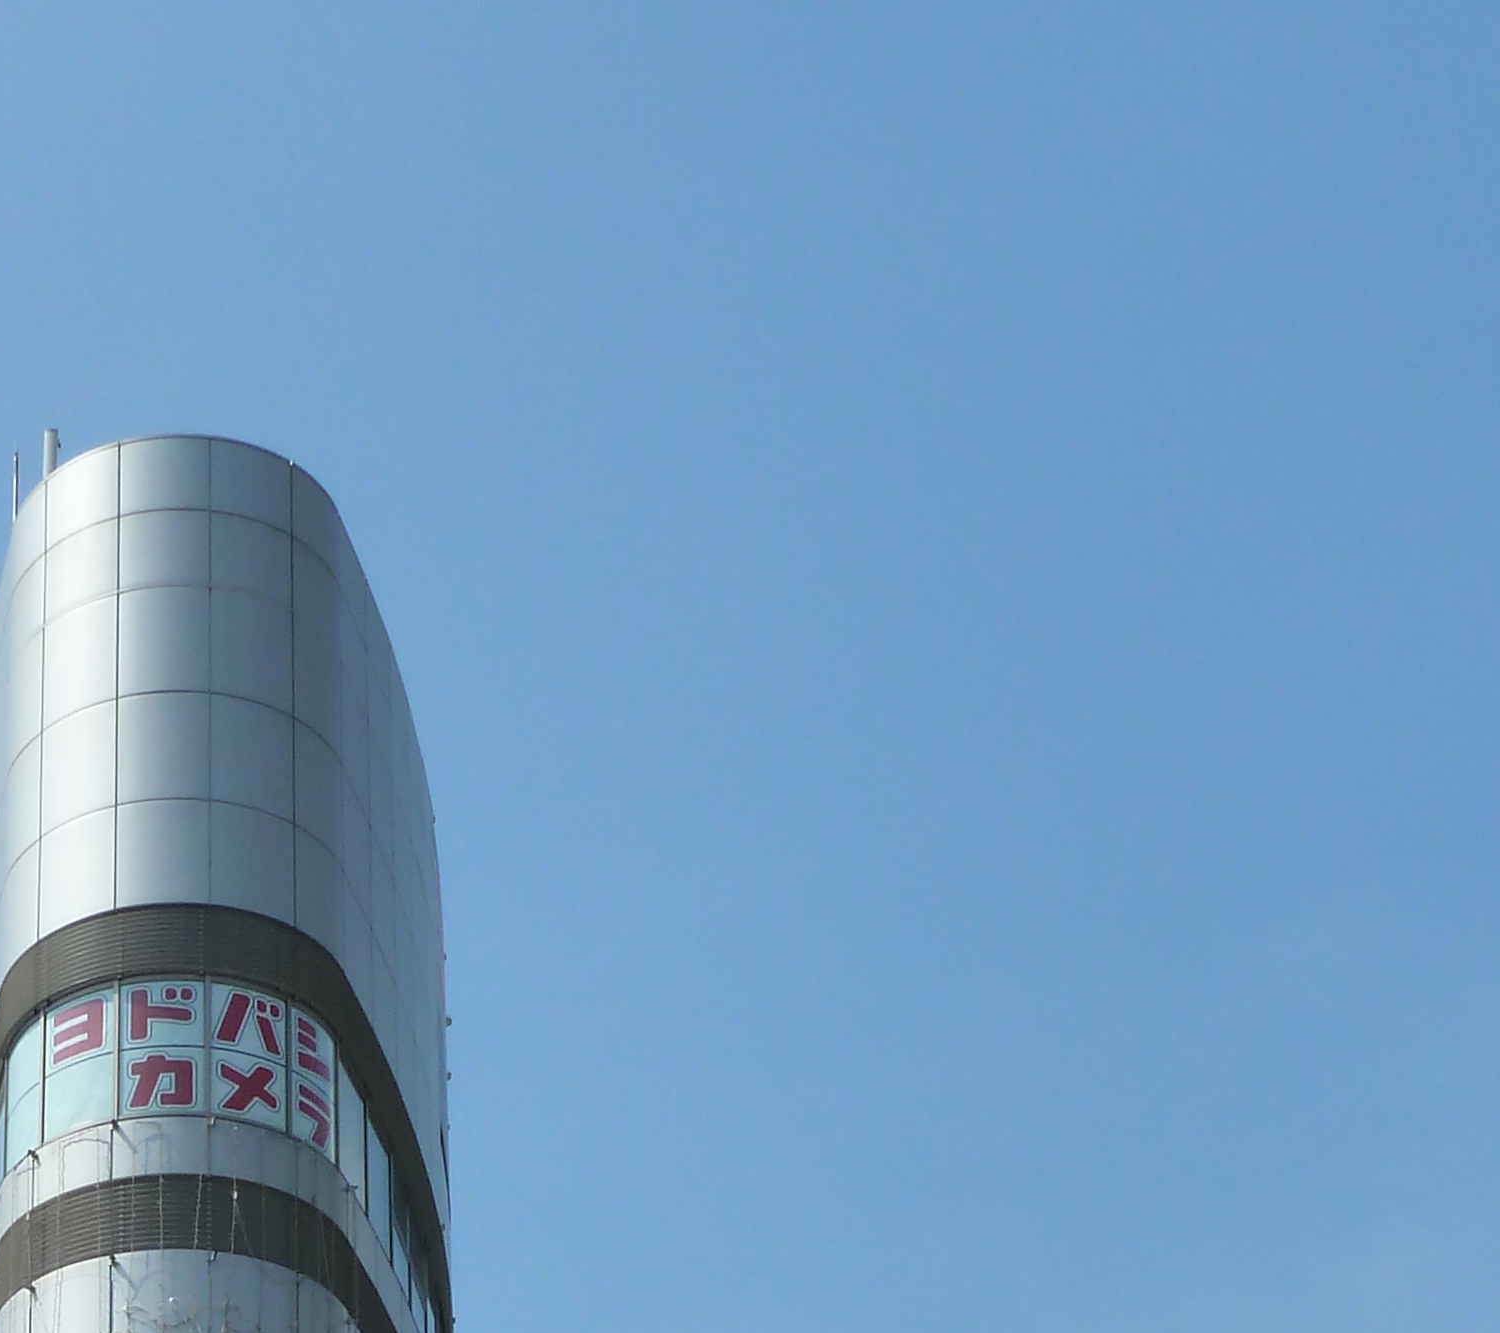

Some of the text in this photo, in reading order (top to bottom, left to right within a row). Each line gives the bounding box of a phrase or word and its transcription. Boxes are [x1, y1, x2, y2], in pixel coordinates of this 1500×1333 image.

[51, 984, 333, 1082] ヨドバシ
[127, 1052, 333, 1149] カメラ
